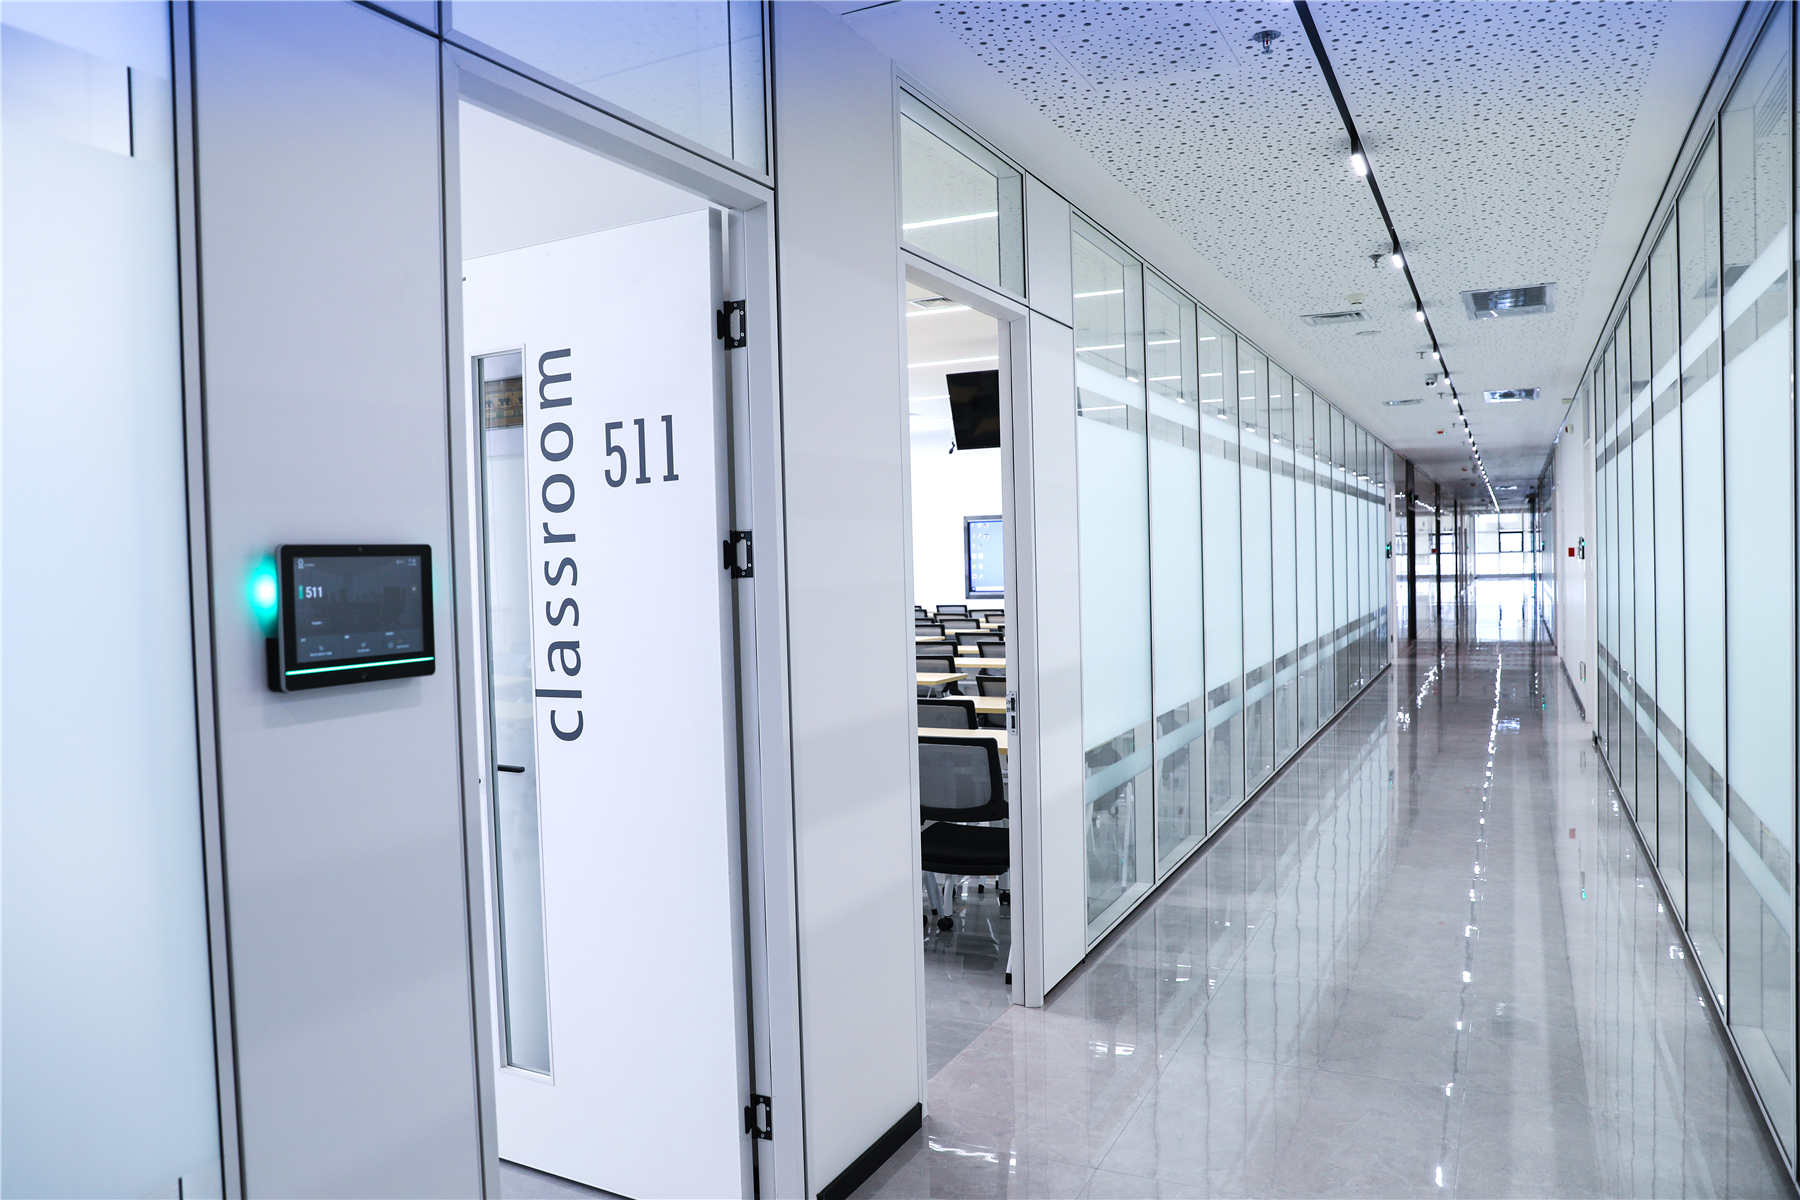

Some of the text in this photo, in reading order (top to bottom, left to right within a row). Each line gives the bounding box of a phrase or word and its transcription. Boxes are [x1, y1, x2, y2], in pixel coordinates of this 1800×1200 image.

[604, 414, 680, 488] 511
[535, 347, 584, 742] classroom
[305, 586, 322, 598] 511
